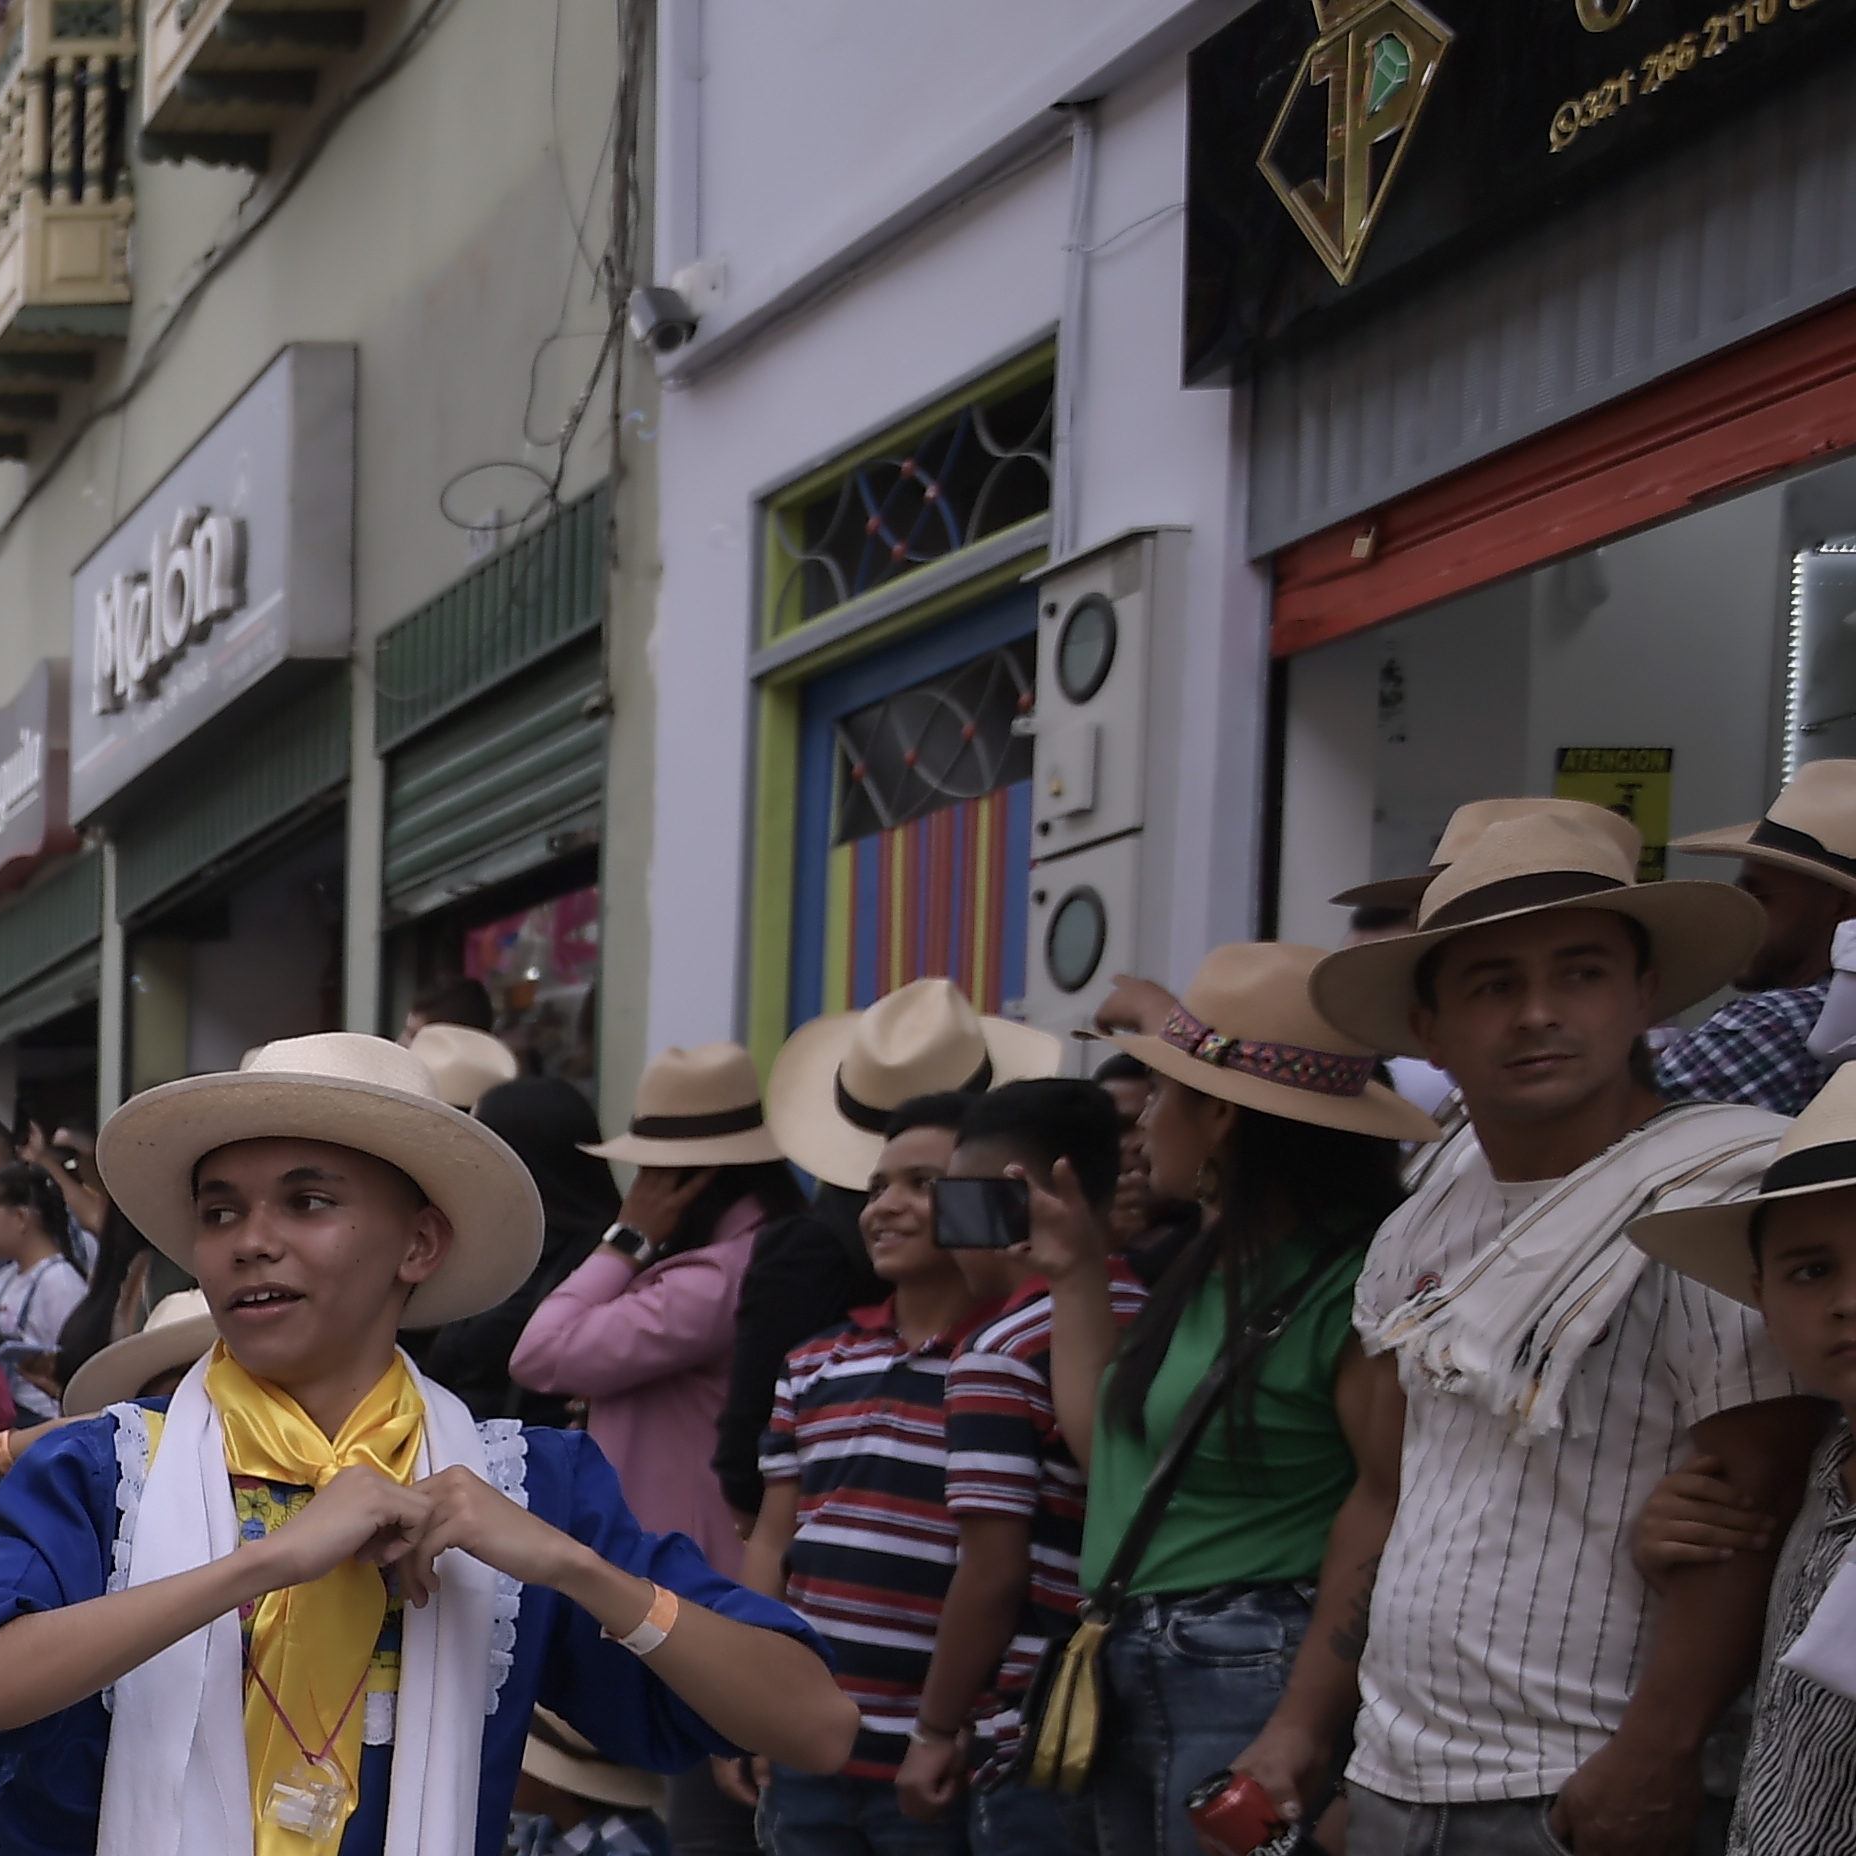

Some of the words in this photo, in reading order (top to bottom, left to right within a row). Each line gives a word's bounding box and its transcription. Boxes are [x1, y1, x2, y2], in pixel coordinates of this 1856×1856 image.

[1579, 66, 1636, 128] 321
[1639, 33, 1698, 95] 266
[92, 507, 235, 714] Melón
